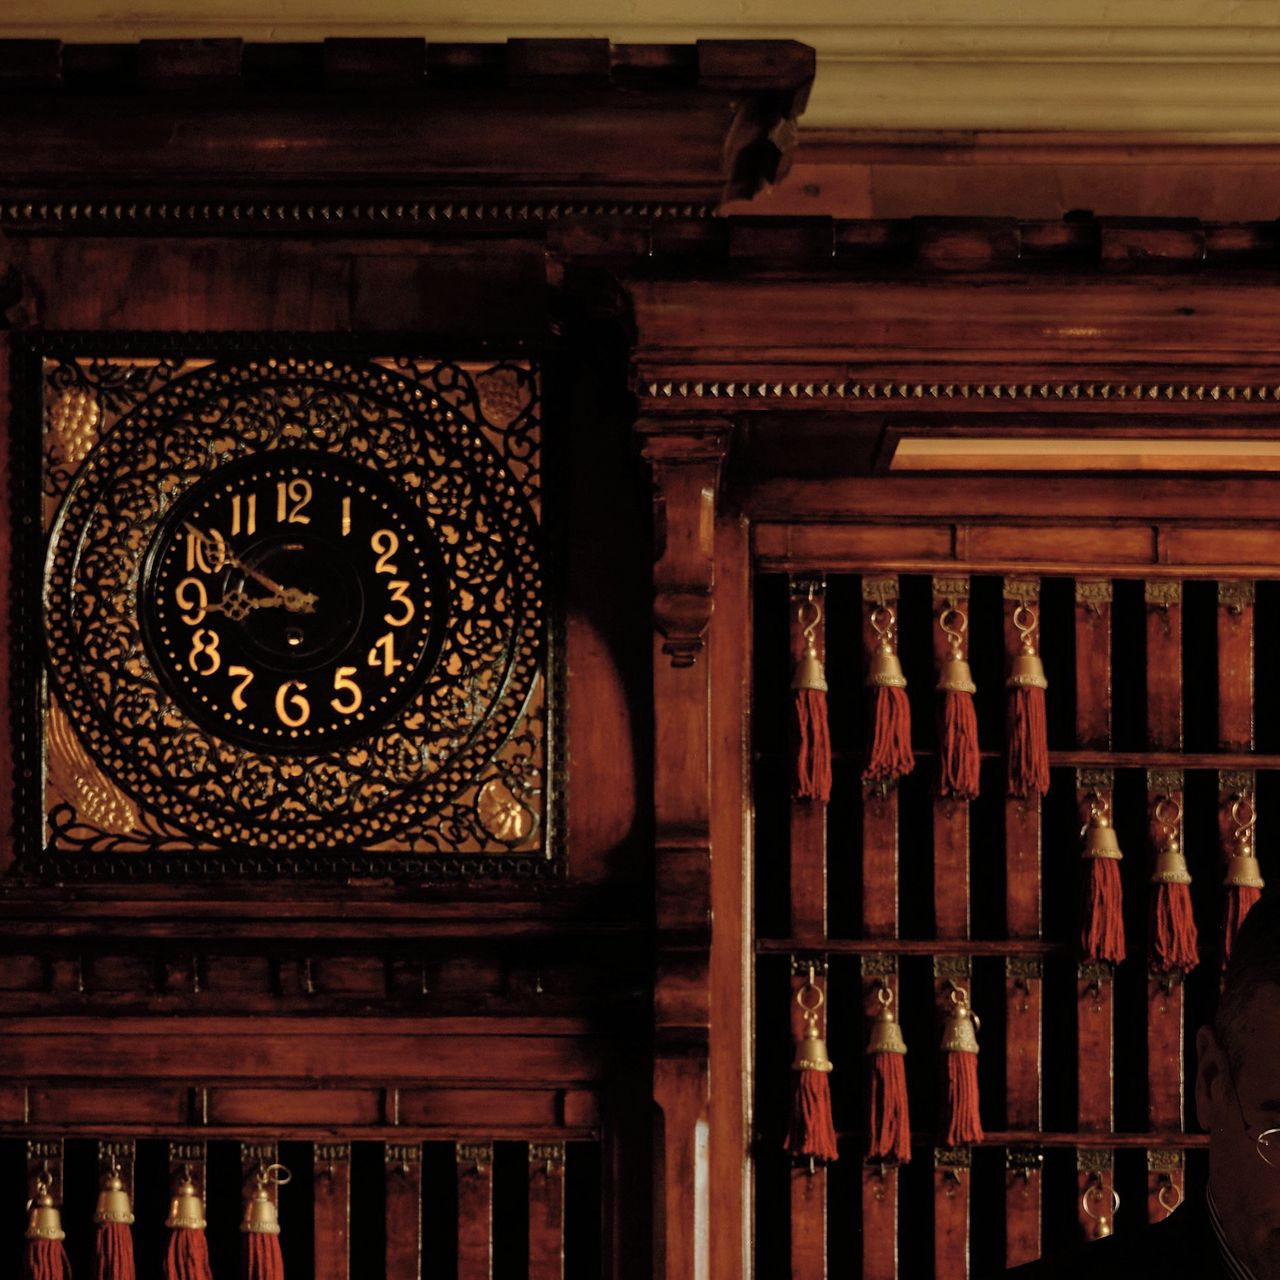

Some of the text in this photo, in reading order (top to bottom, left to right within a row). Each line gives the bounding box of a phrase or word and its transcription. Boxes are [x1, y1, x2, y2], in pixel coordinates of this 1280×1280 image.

[230, 493, 258, 536] 11
[276, 477, 313, 525] 12
[341, 496, 351, 537] 1
[185, 531, 225, 575] 10
[370, 528, 400, 575] 2
[174, 578, 209, 626] 9
[383, 579, 416, 627] 3
[188, 629, 221, 677] 8
[367, 632, 402, 677] 4
[227, 665, 255, 712] 7
[275, 680, 311, 727] 6
[329, 666, 363, 714] 5
